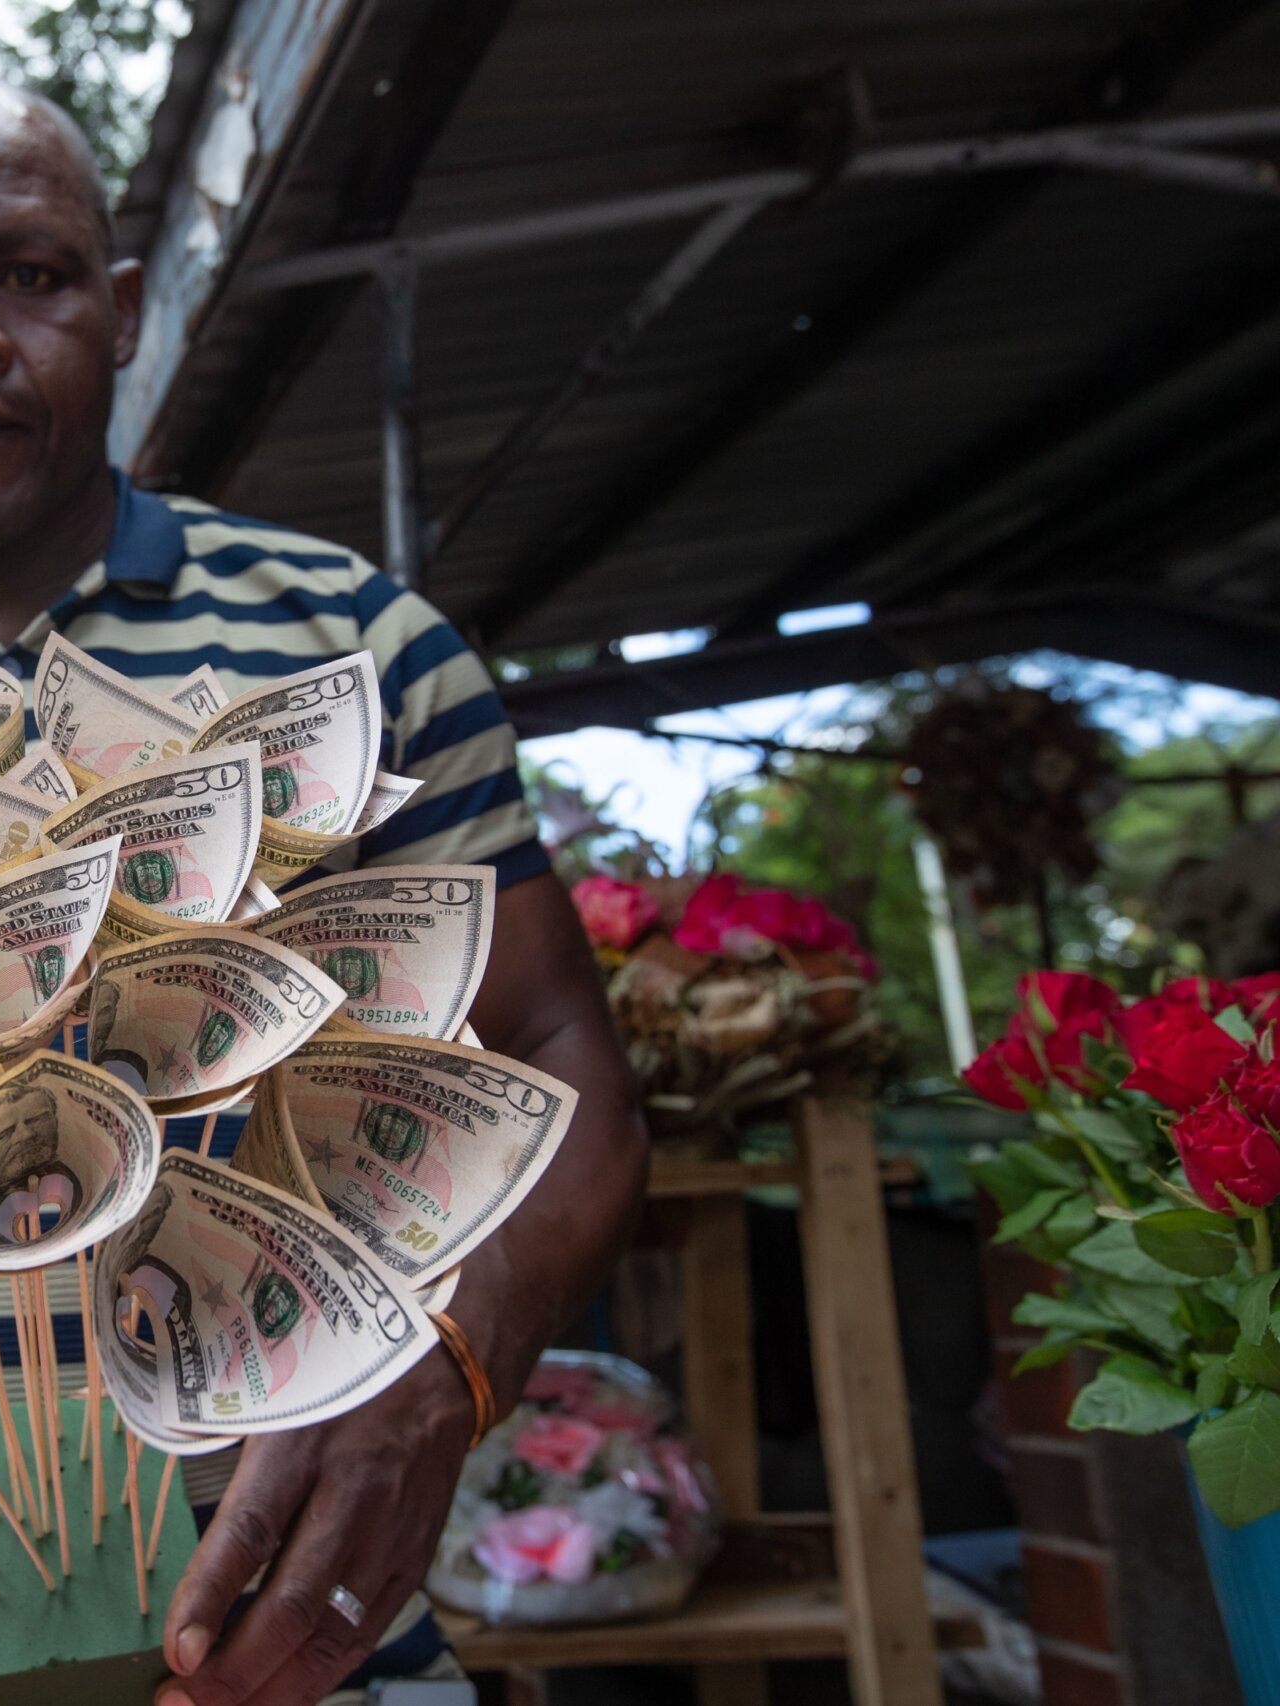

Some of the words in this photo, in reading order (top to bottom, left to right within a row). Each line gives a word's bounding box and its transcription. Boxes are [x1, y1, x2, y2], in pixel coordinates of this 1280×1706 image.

[39, 659, 68, 723] 50
[287, 673, 357, 712] 50
[224, 705, 262, 727] NOTE
[244, 711, 332, 744] STATES
[144, 740, 156, 751] C
[173, 765, 242, 797] 50
[104, 787, 147, 806] NOTE
[105, 807, 144, 824] THE
[126, 802, 218, 832] STATES
[66, 855, 108, 891] 50
[1, 879, 45, 901] NOTE
[320, 887, 365, 900] NOTE
[391, 880, 473, 906] 50
[6, 900, 45, 917] THE
[30, 896, 92, 924] STATES
[335, 912, 436, 929] STATES
[444, 907, 452, 916] H
[2, 916, 84, 952] AMERICA
[294, 927, 422, 946] AMERICA
[220, 945, 265, 968] NOTE
[214, 959, 252, 985] THE
[134, 963, 231, 984] UNITED
[230, 978, 287, 1030] STATES
[193, 977, 268, 1039] AMERICA
[278, 972, 322, 1020] 50
[346, 1007, 418, 1024] 43951894
[422, 1011, 430, 1022] A
[380, 1048, 439, 1065] NOTE
[292, 1064, 395, 1082] UNITED
[395, 1074, 500, 1126] STATES
[309, 1074, 347, 1089] OF
[348, 1076, 477, 1136] AMERICA
[463, 1066, 549, 1118] 50
[510, 1114, 518, 1122] A
[354, 1154, 377, 1177] ME
[376, 1167, 442, 1219] 76065724
[439, 1211, 452, 1224] A
[280, 1207, 331, 1247] NOTE
[394, 1220, 439, 1253] 50
[190, 1187, 291, 1249] UNITED
[289, 1244, 363, 1335] STATES
[245, 1222, 340, 1337] AMERICA
[346, 1262, 408, 1343] 50
[230, 1316, 246, 1340] PB
[211, 1390, 243, 1415] 50
